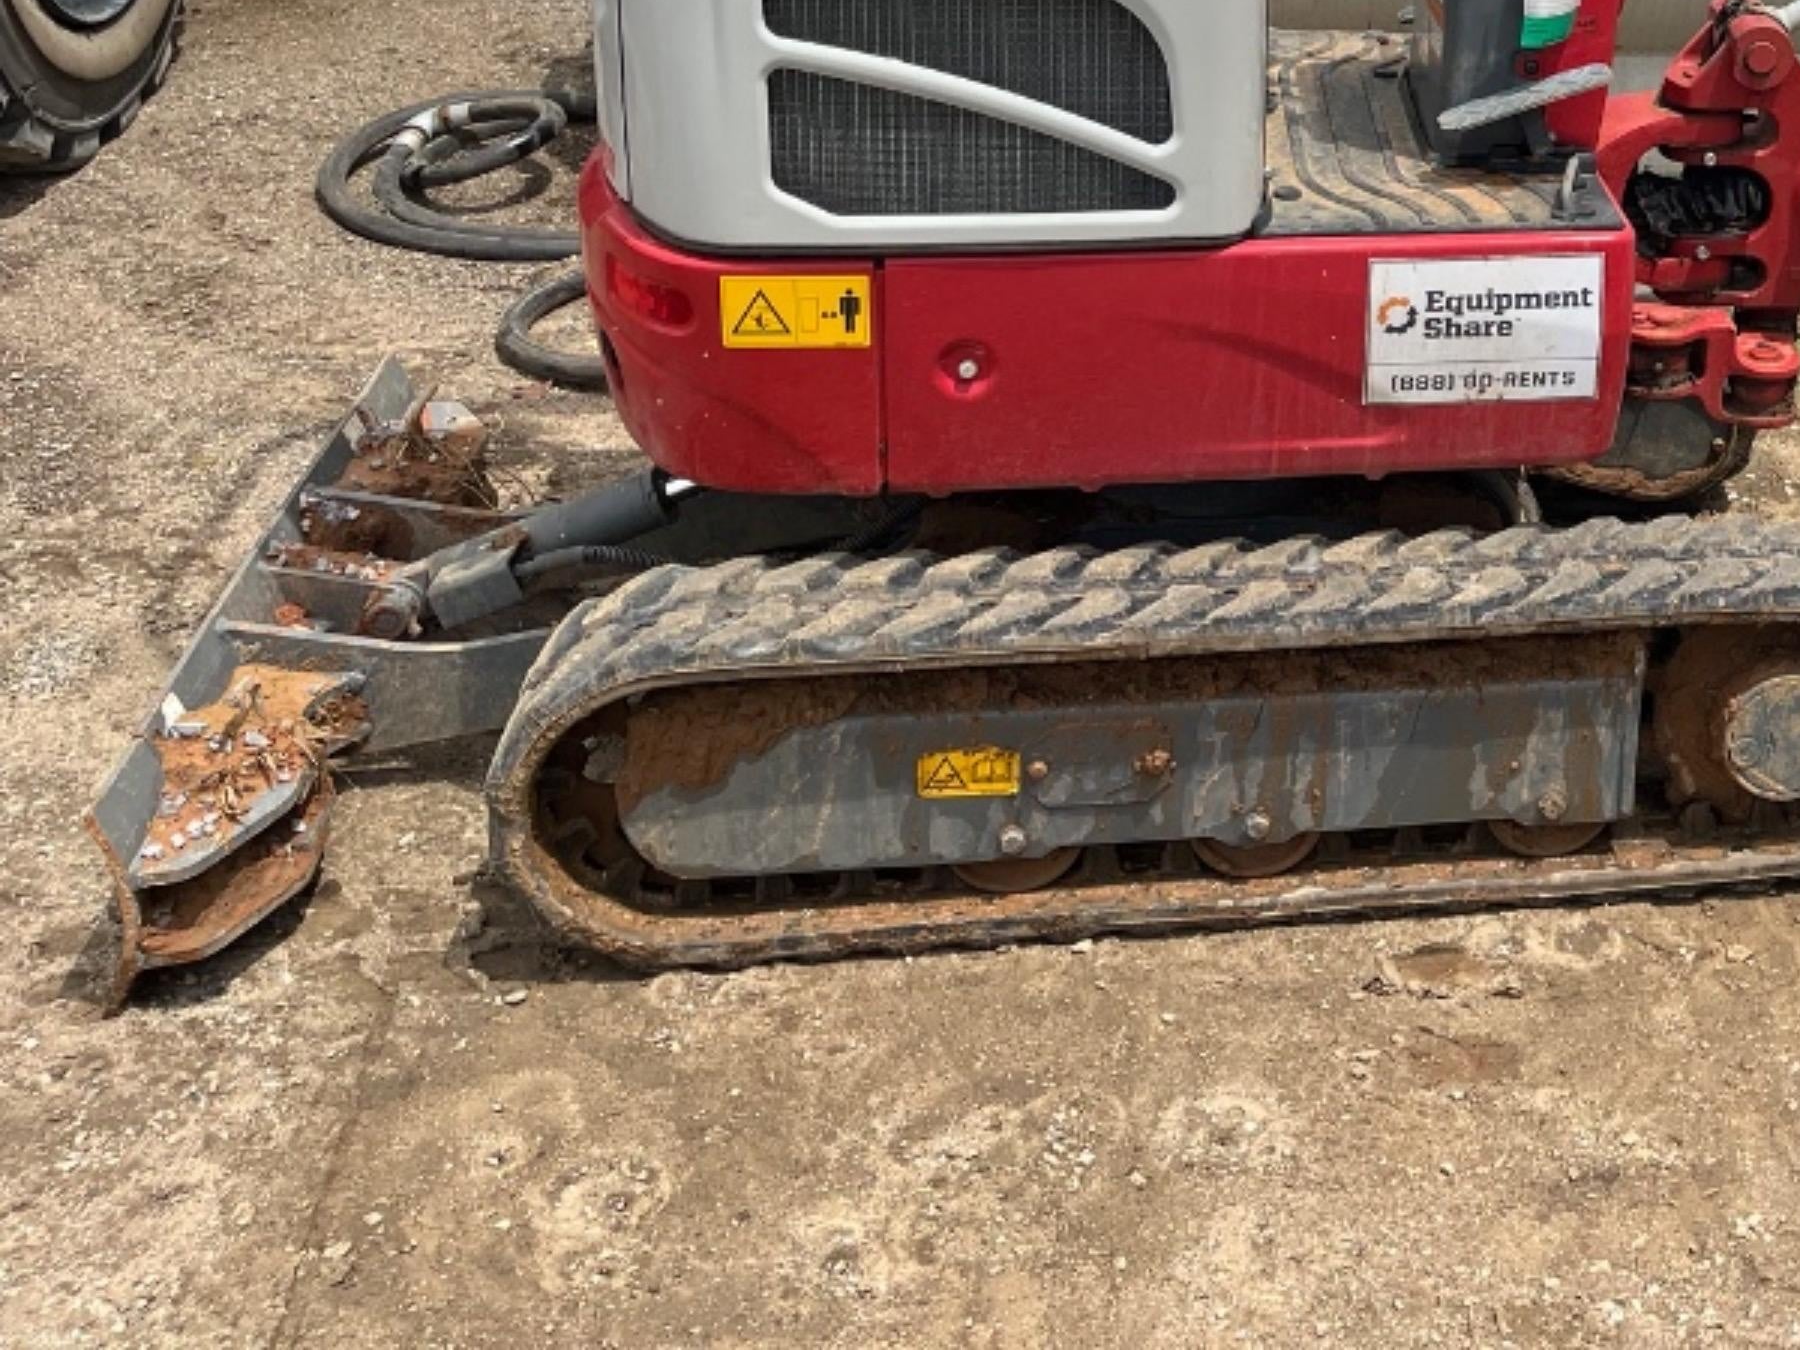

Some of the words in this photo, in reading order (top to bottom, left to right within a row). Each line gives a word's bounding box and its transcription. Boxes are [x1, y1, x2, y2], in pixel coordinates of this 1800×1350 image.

[1424, 287, 1594, 315] Equipment
[1423, 317, 1514, 339] Share
[1391, 373, 1456, 392] (888)
